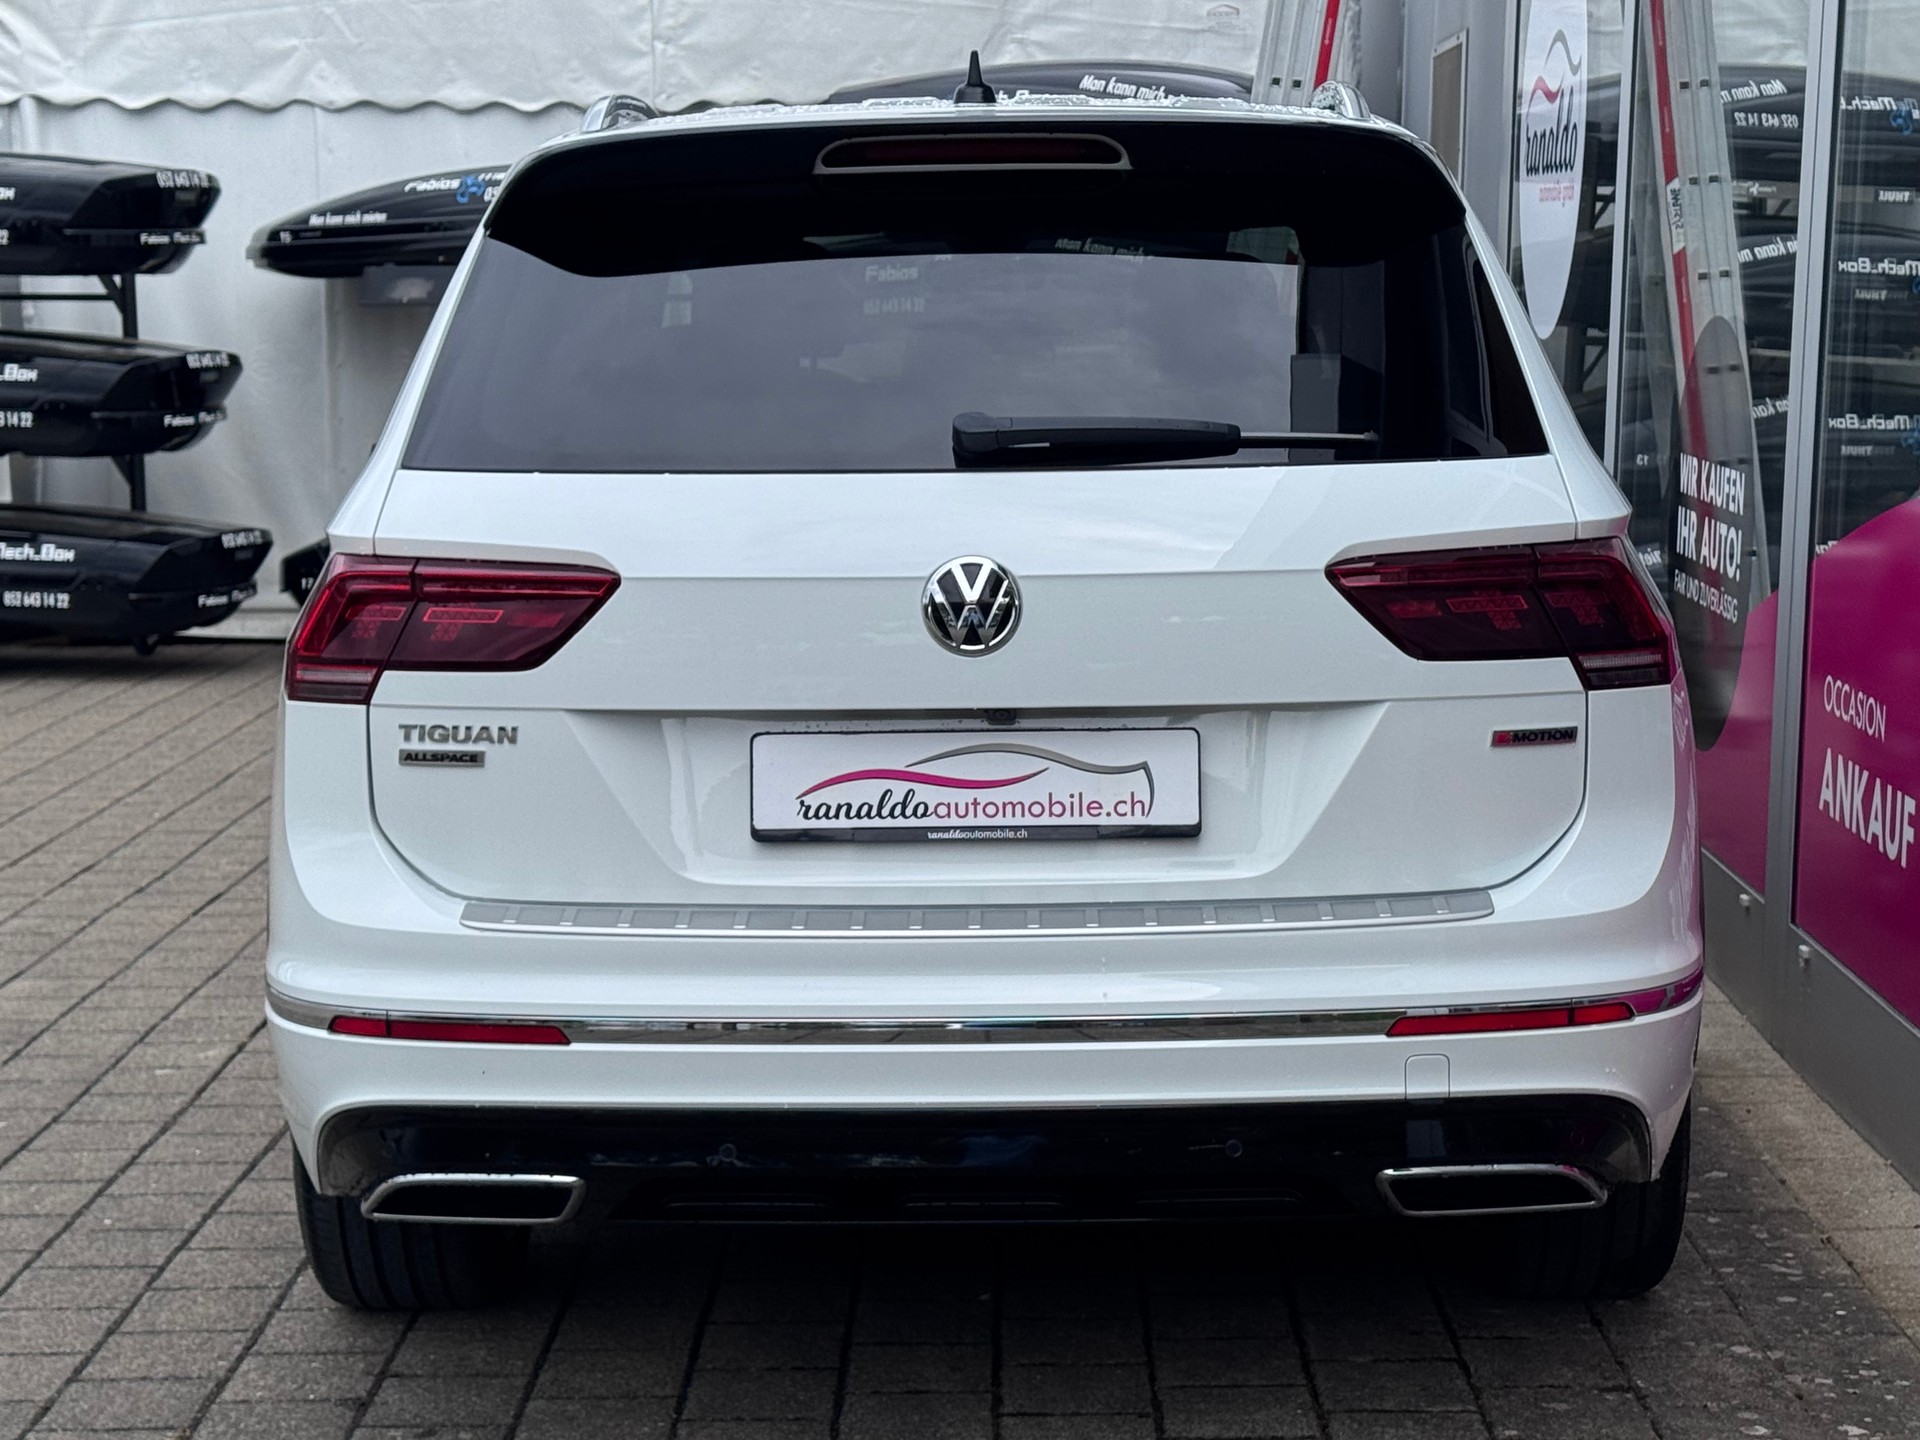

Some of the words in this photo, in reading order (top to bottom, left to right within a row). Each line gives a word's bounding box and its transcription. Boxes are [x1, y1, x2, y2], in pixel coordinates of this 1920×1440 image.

[1079, 75, 1106, 92] Man
[1106, 76, 1137, 97] kann
[1525, 86, 1578, 177] ranaldo
[1680, 452, 1698, 498] WIR
[1700, 459, 1746, 516] KAUFEN
[1676, 505, 1698, 562] IHR
[1700, 515, 1743, 582] AUTO!
[1824, 674, 1886, 742] OCCASION
[398, 723, 519, 746] TIGUAN
[404, 752, 479, 763] ALLSPACE
[796, 788, 1147, 821] ranaldoautomobile.ch
[1818, 747, 1916, 869] ANKAUF
[927, 828, 1028, 840] ranaldoautomobile.ch
